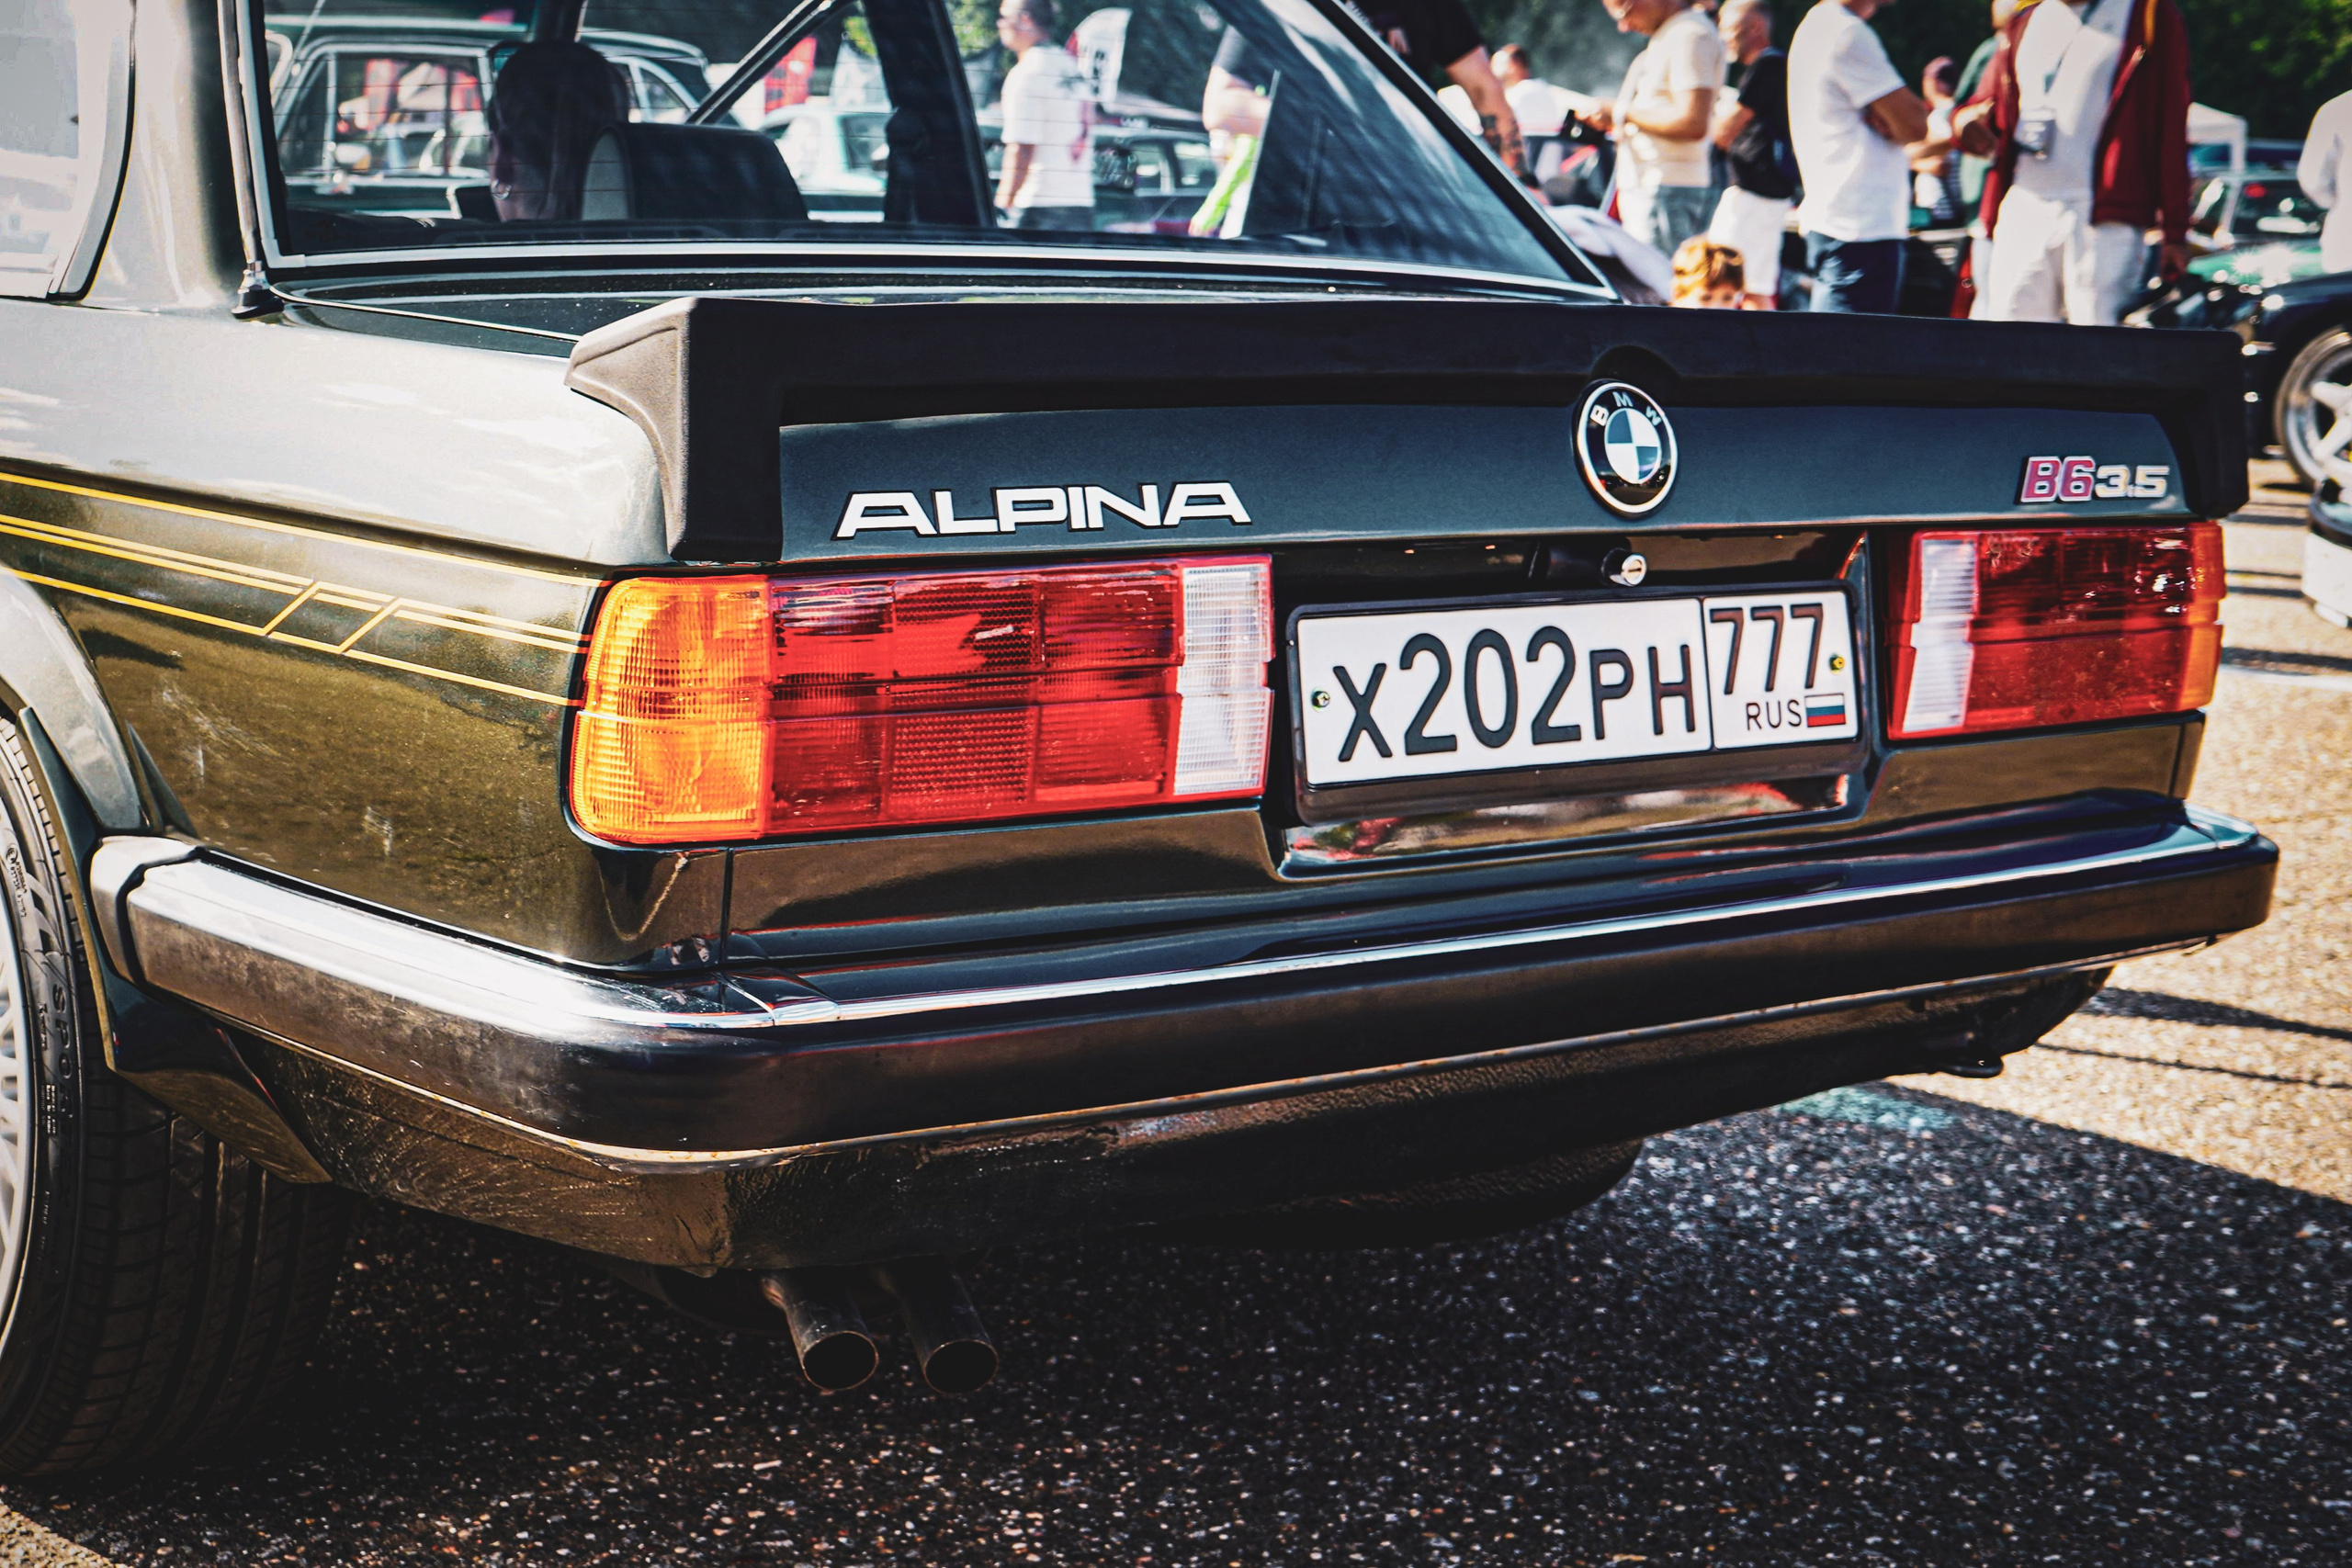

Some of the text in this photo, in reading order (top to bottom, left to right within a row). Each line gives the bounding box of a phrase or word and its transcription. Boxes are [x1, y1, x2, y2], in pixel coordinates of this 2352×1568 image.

[1589, 390, 1662, 427] BMW
[831, 480, 1252, 539] ALPINA
[1709, 602, 1825, 695] 777
[1745, 699, 1803, 732] RUS
